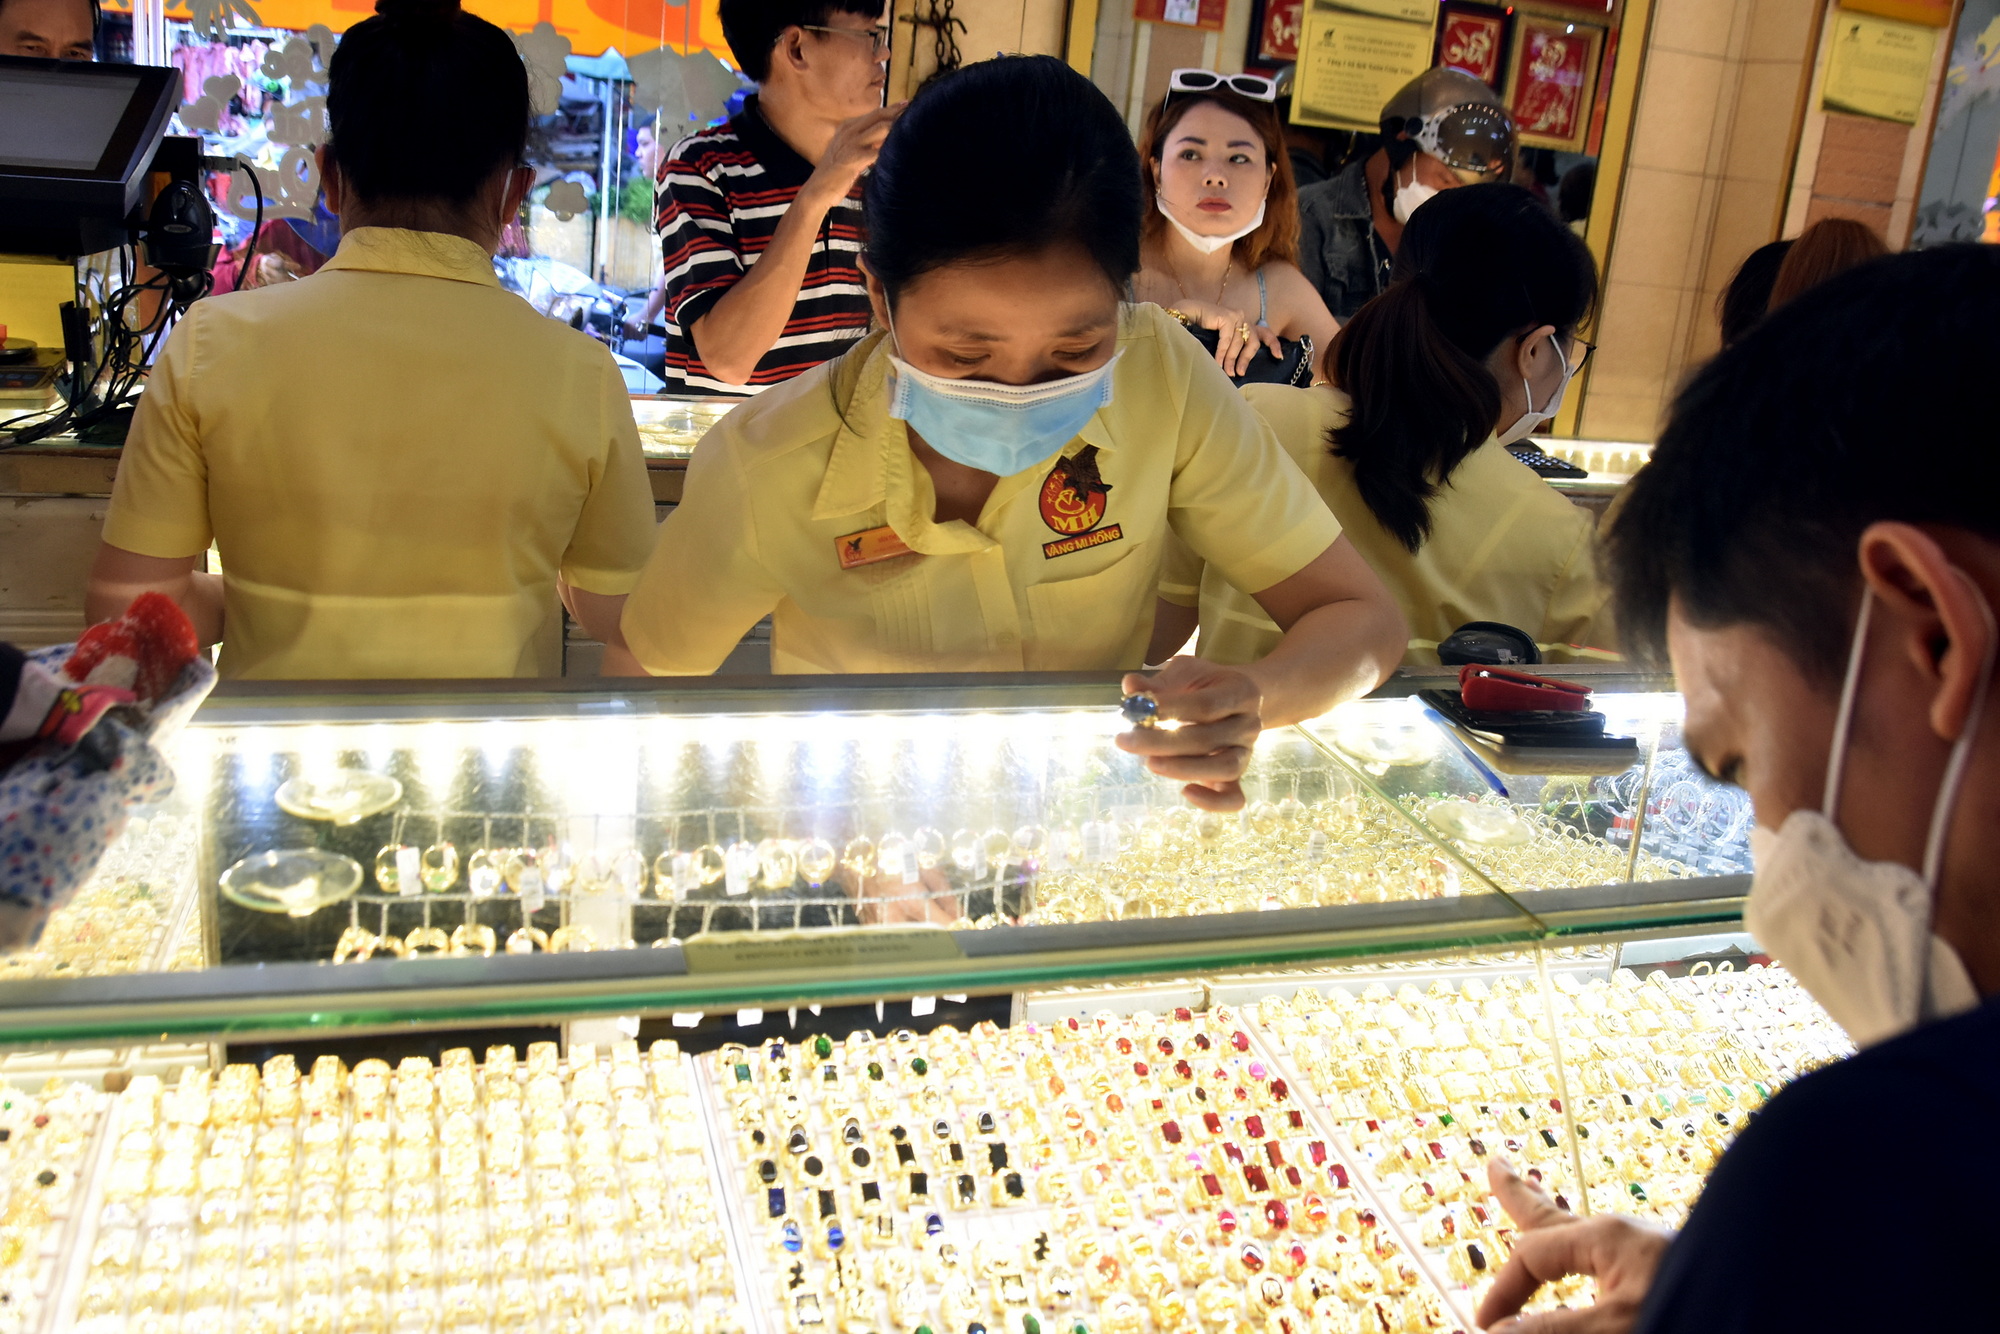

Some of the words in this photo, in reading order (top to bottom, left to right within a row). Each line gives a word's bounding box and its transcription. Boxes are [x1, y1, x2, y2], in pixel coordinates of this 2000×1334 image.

[1051, 503, 1100, 532] MH
[1045, 543, 1075, 557] VÀNG
[1075, 538, 1089, 549] MI
